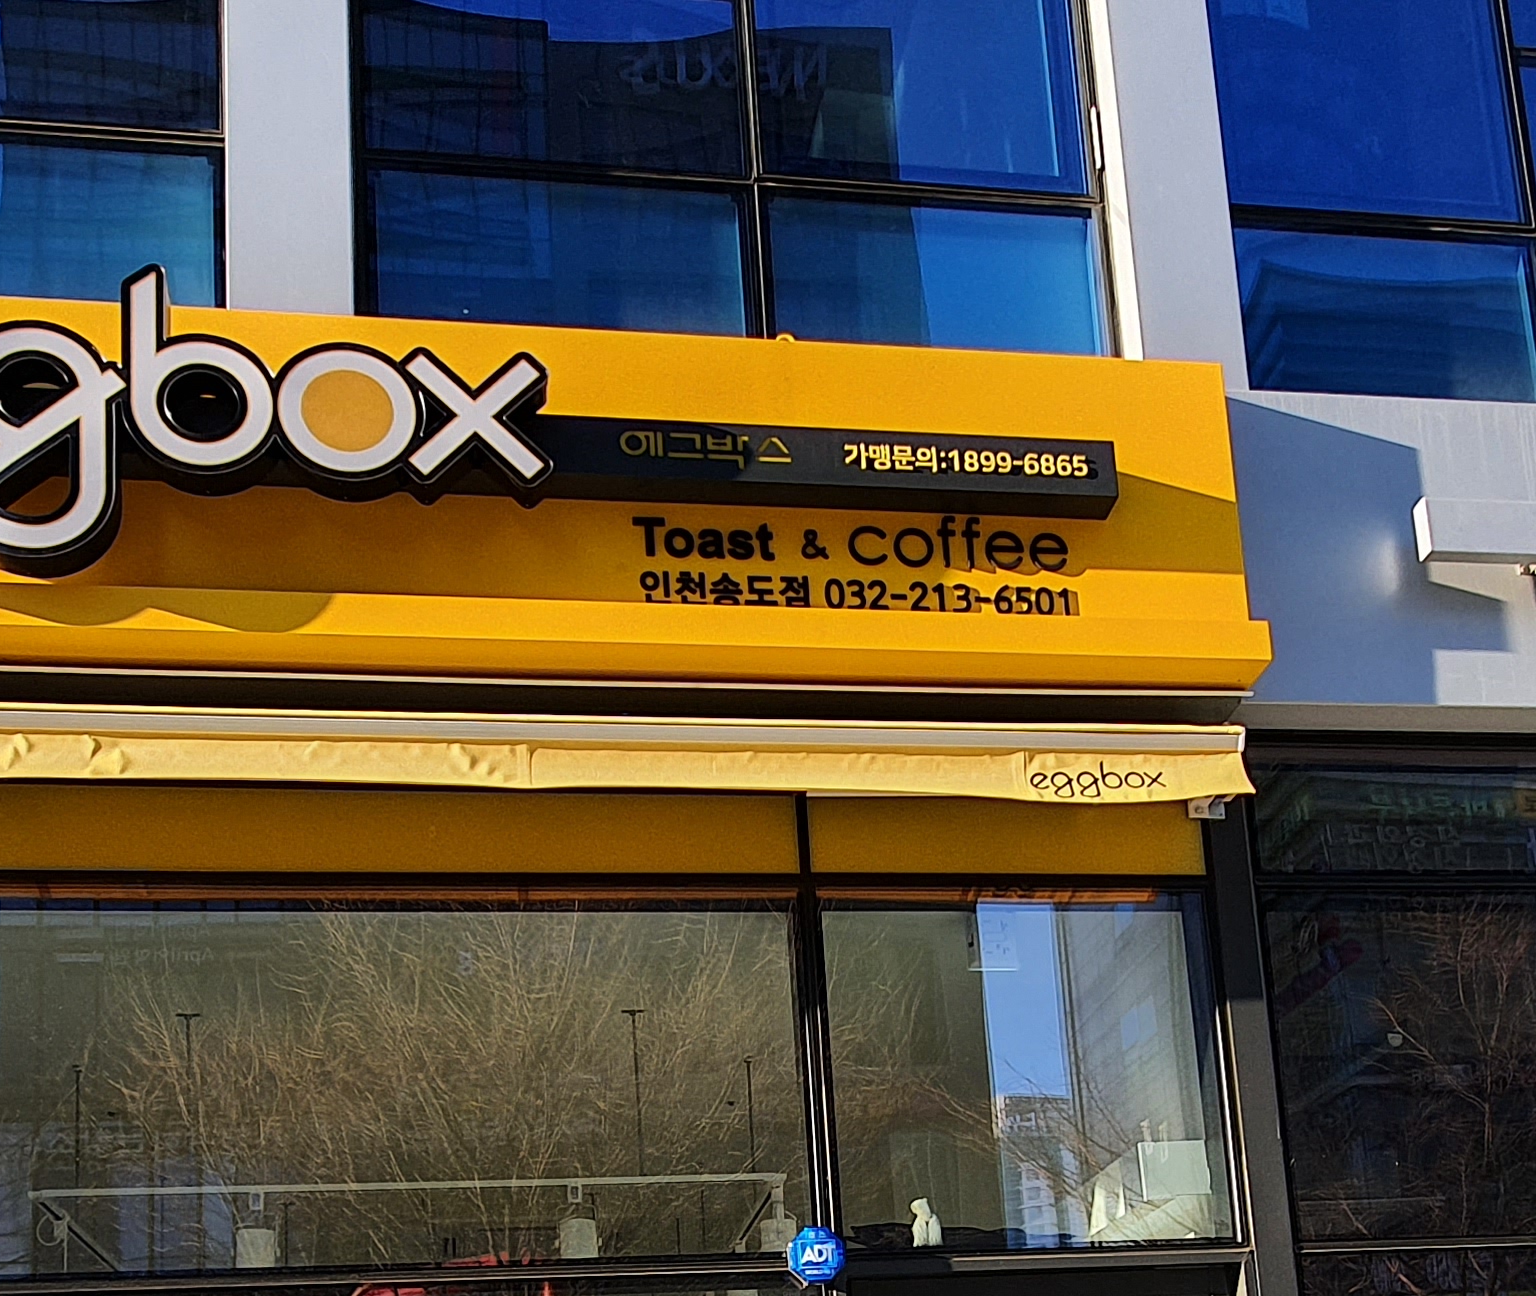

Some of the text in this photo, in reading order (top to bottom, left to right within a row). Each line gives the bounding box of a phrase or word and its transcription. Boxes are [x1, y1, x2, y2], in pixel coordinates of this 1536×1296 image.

[618, 429, 1090, 478] 에그박스 가맹문의:1899-6865
[632, 516, 1070, 573] Toast & coffee
[638, 570, 1078, 616] 인천송도점 032-213-6501
[1029, 761, 1167, 799] eggbox
[801, 1245, 836, 1264] ADT
